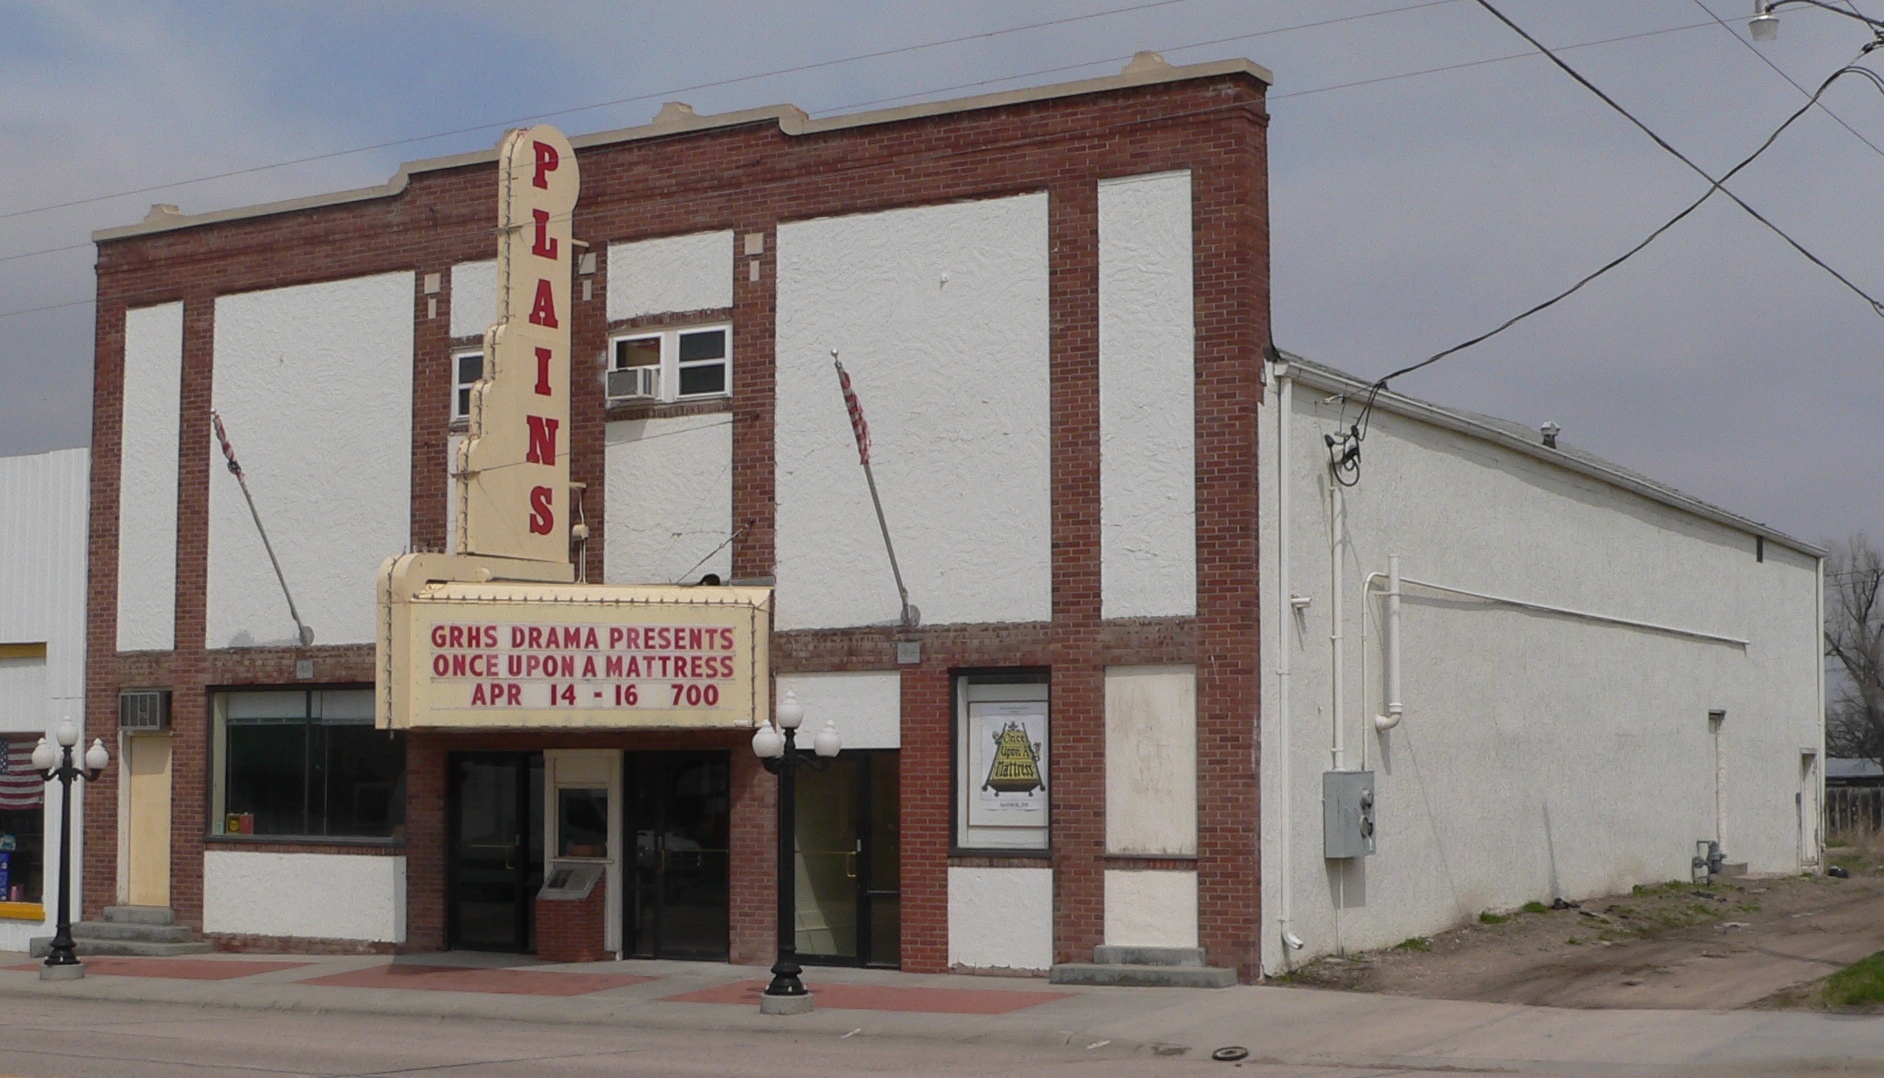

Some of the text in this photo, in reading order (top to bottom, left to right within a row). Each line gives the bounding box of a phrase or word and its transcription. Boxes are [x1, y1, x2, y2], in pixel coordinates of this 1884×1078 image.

[526, 140, 560, 536] PLAINS
[431, 625, 734, 650] GRHS DRAMA PRESENTS
[433, 654, 734, 678] ONCE UPON A MATTRESS
[471, 683, 522, 706] APR
[550, 684, 576, 706] 14
[615, 684, 638, 706] 16
[671, 684, 719, 706] 700
[1003, 733, 1025, 743] Once
[1000, 745, 1021, 759] Upon
[995, 761, 1034, 778] Mattress
